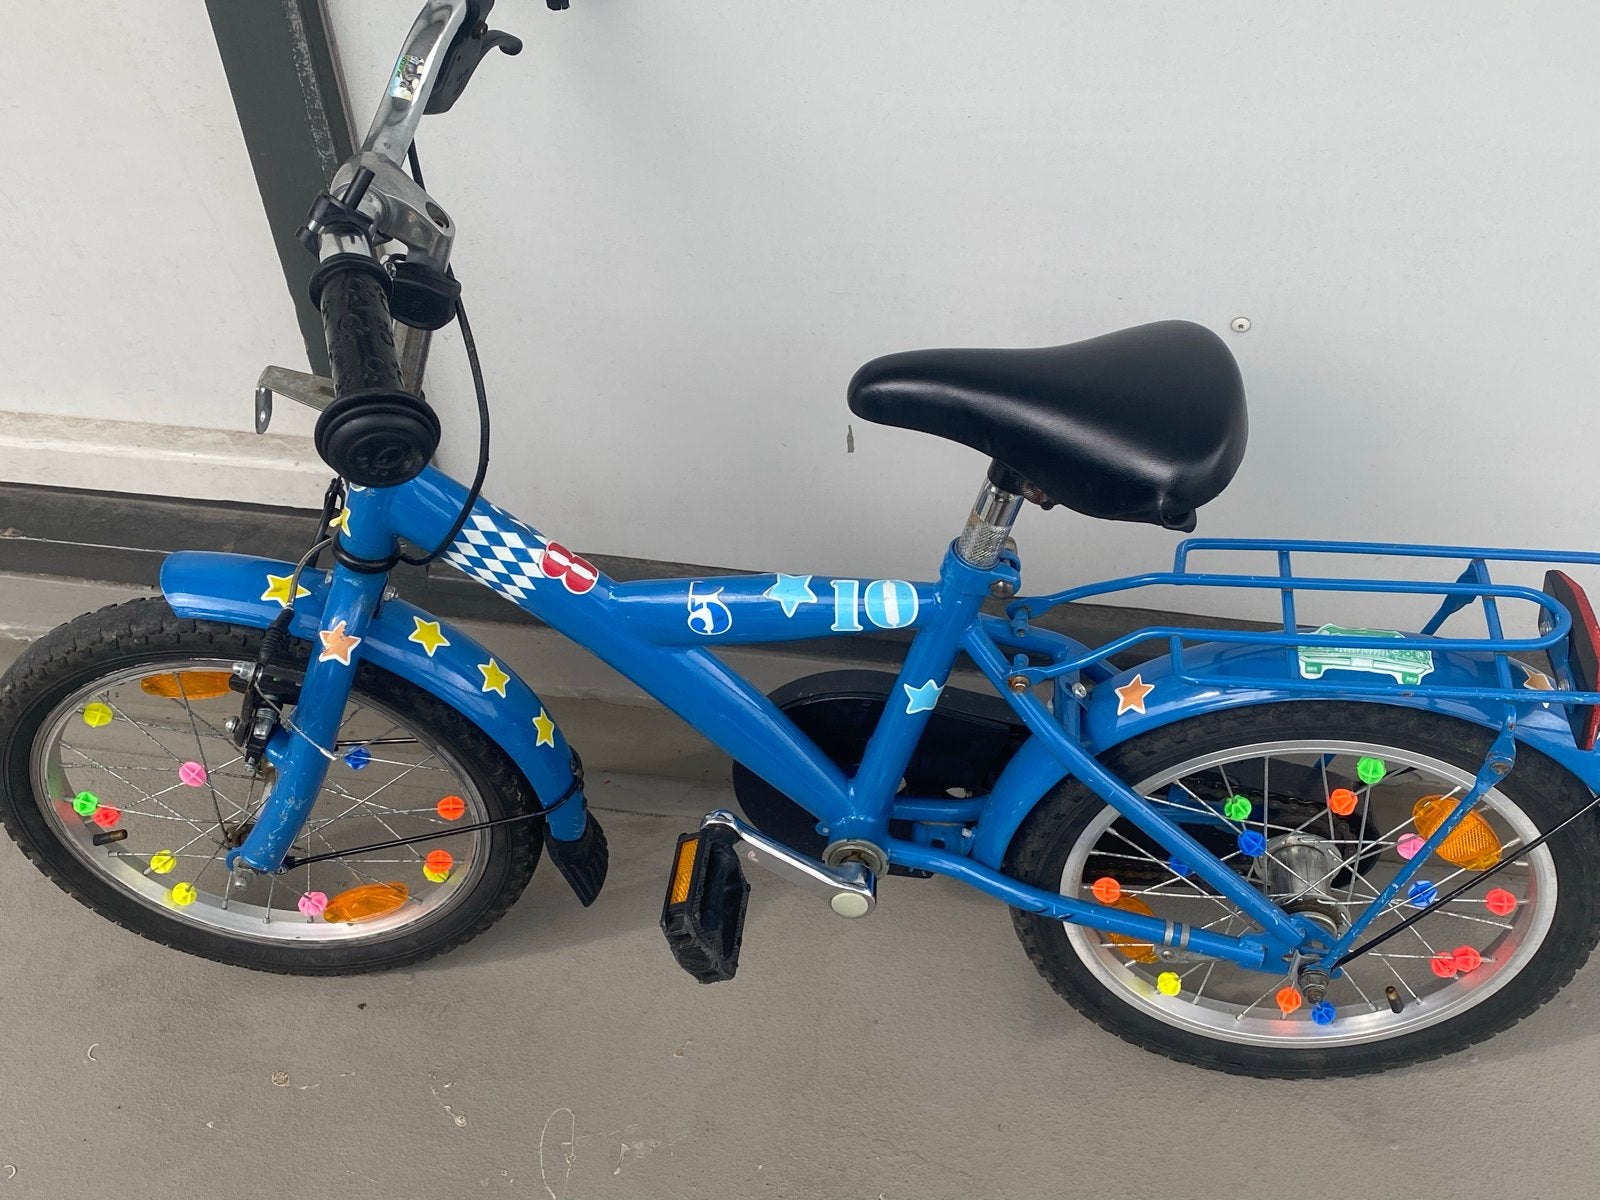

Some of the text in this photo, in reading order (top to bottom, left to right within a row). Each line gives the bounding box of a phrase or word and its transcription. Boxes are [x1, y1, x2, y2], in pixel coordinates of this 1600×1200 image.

[539, 540, 600, 595] 8
[687, 580, 733, 636] 5
[830, 579, 919, 632] 10
